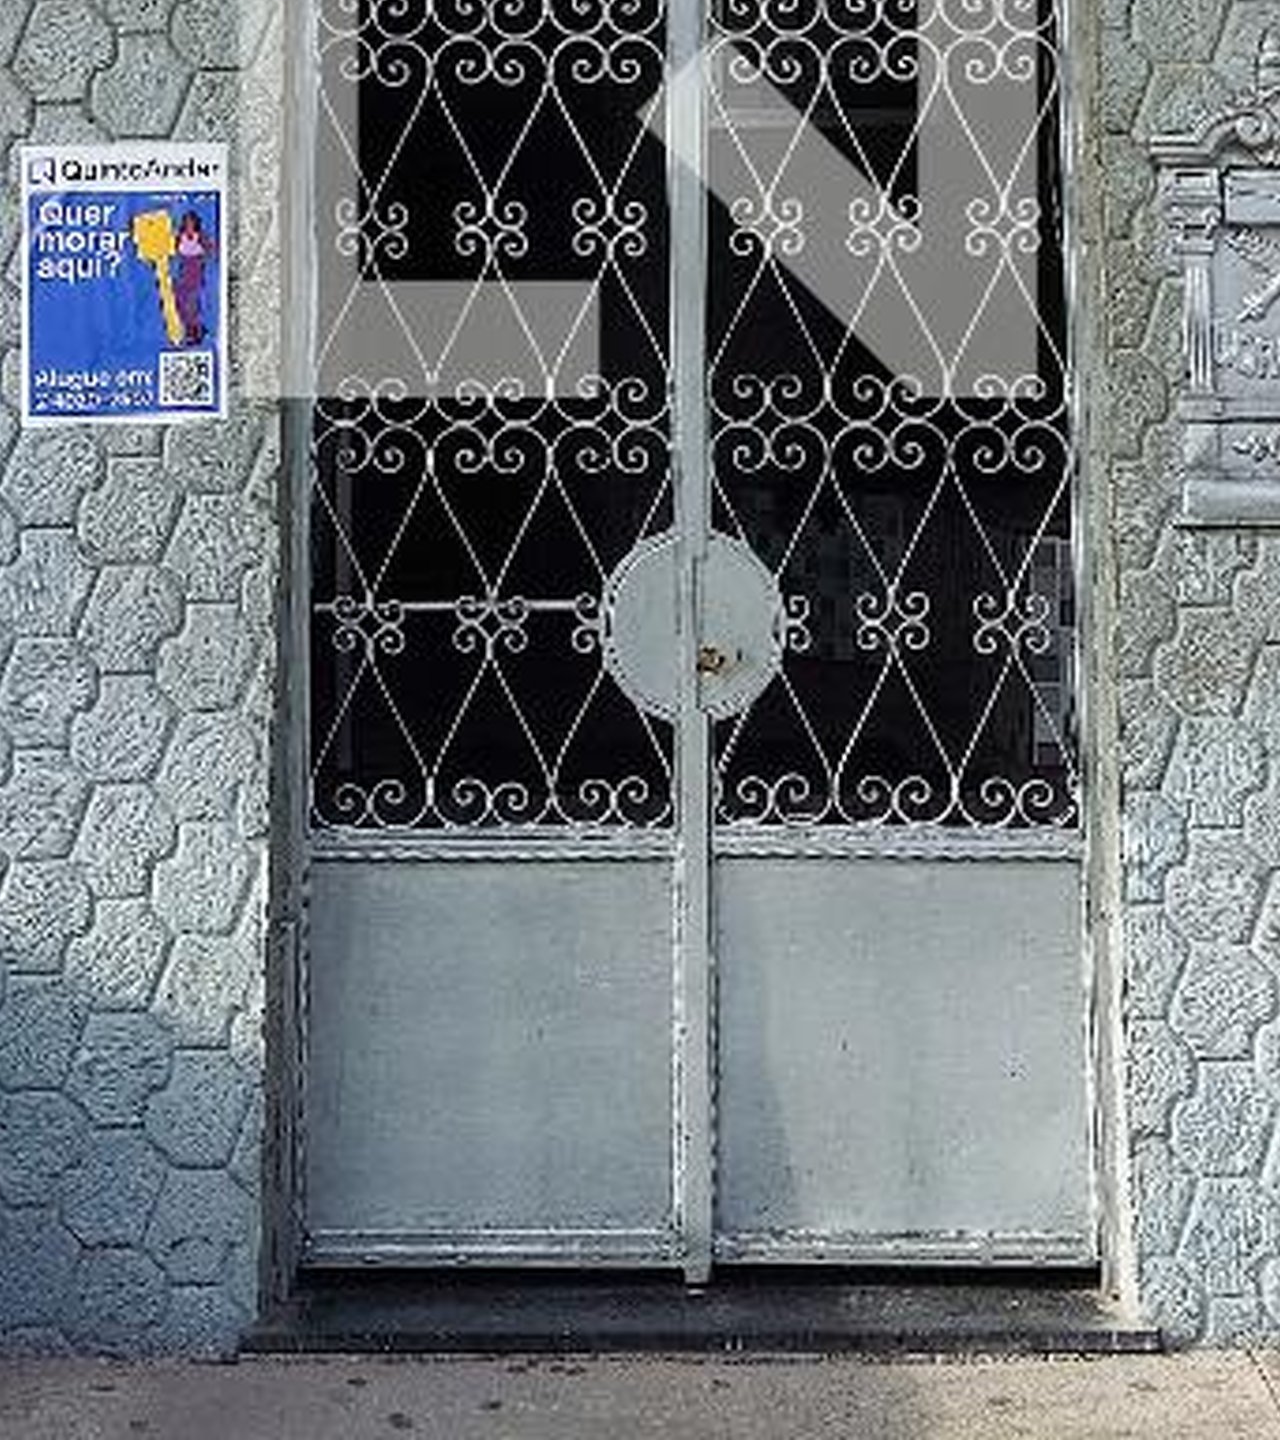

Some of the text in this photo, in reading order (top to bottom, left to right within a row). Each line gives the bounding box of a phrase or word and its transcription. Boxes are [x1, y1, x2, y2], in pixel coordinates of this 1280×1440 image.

[38, 201, 117, 226] Quer
[37, 229, 130, 252] morar
[36, 251, 121, 284] aqui?
